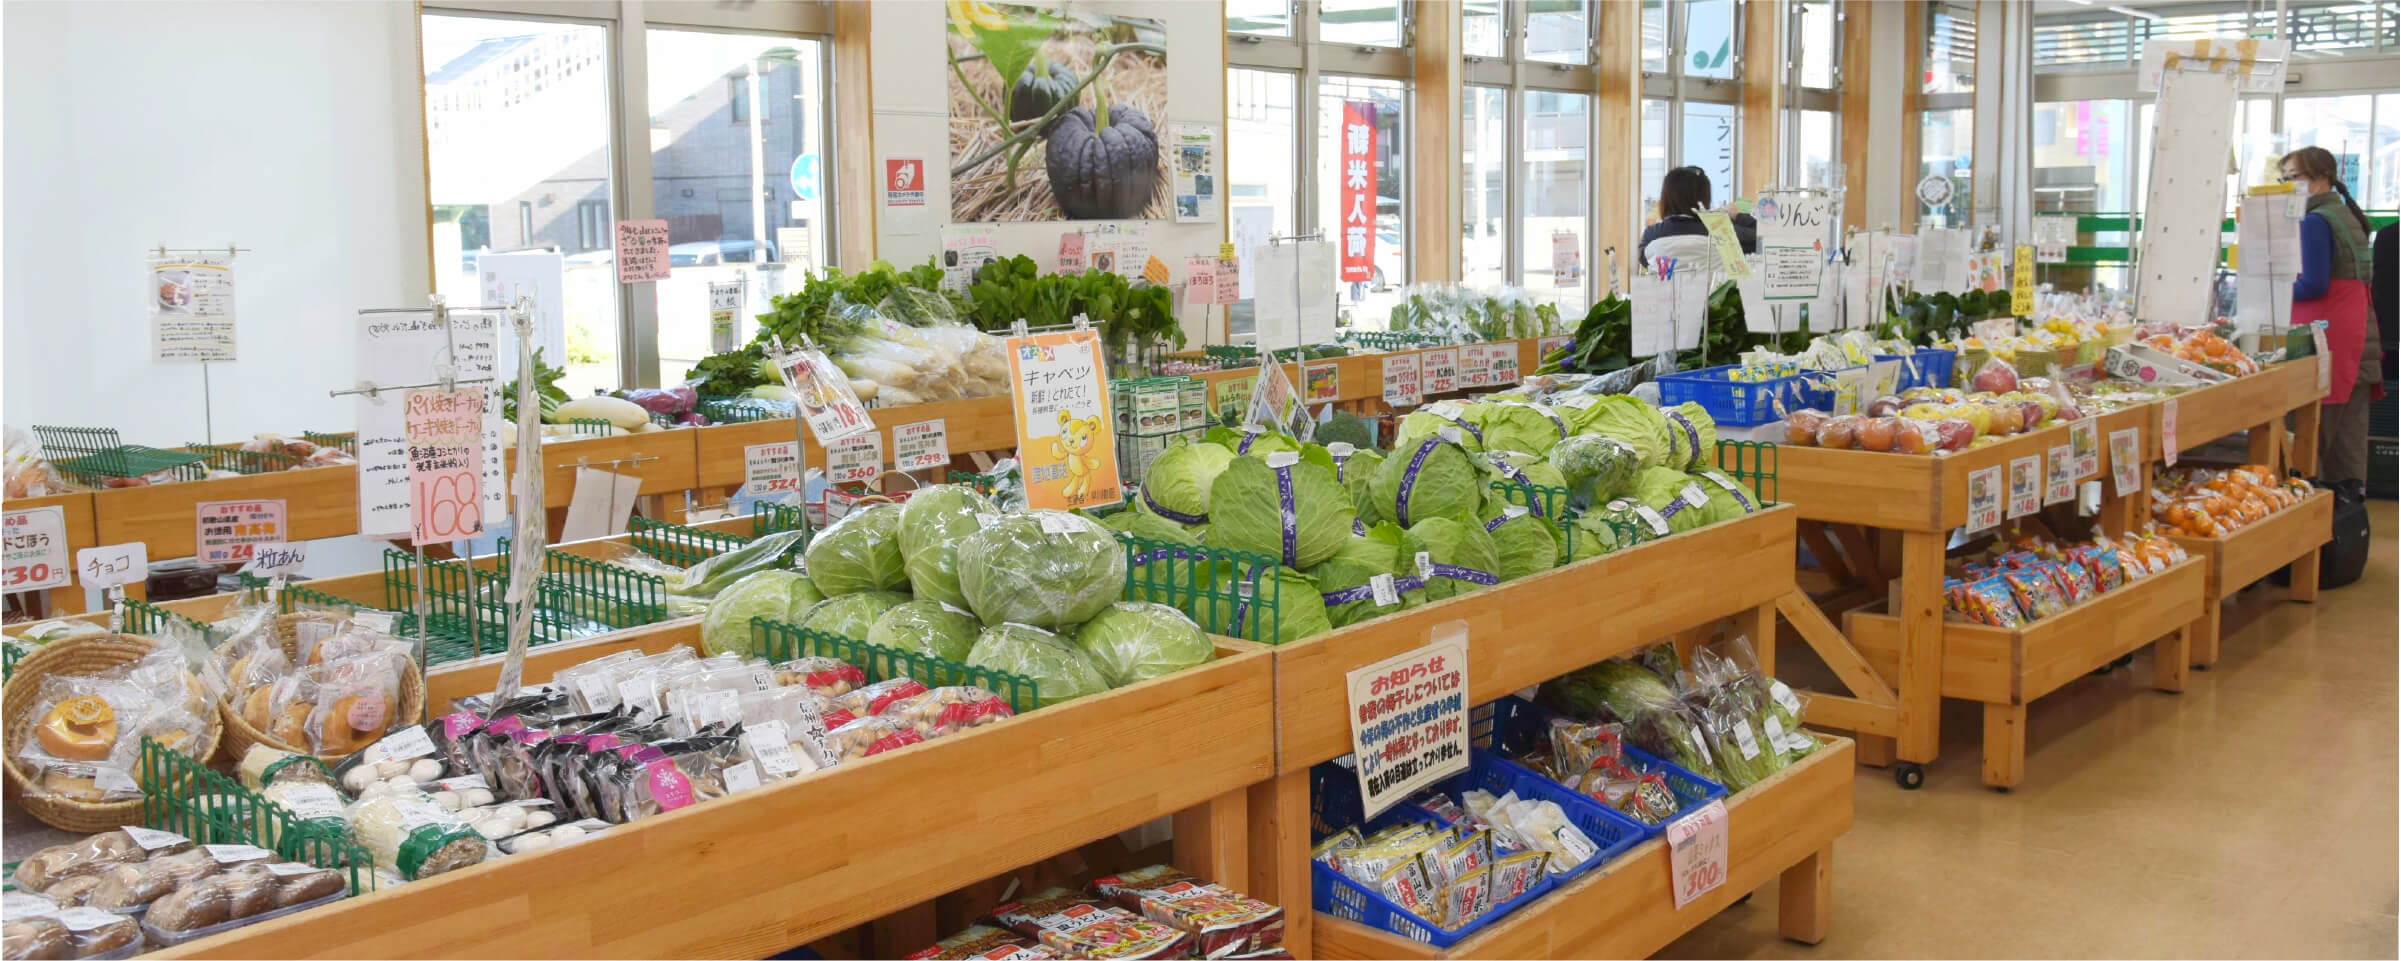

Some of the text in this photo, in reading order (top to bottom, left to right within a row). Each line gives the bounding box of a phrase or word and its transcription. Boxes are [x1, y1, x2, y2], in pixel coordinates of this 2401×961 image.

[1779, 202, 1824, 228] りんご
[1023, 365, 1091, 386] キャベツ
[1471, 374, 1489, 384] 457
[1399, 383, 1416, 396] 358
[1434, 379, 1451, 391] 225
[405, 393, 483, 416] パイ焼きドーナツ
[408, 445, 470, 462] 魚沼産コシヒカリの
[914, 453, 942, 466] 298
[847, 466, 875, 480] 360
[768, 478, 798, 492] 324
[220, 504, 262, 514] おすすめ品
[420, 472, 481, 540] 168
[5, 515, 28, 526] め品
[234, 522, 275, 536] 南高梅
[87, 554, 130, 578] チョコ
[255, 548, 305, 569] 粒あん
[1370, 656, 1446, 696] お知らせ
[1687, 862, 1718, 896] 300
